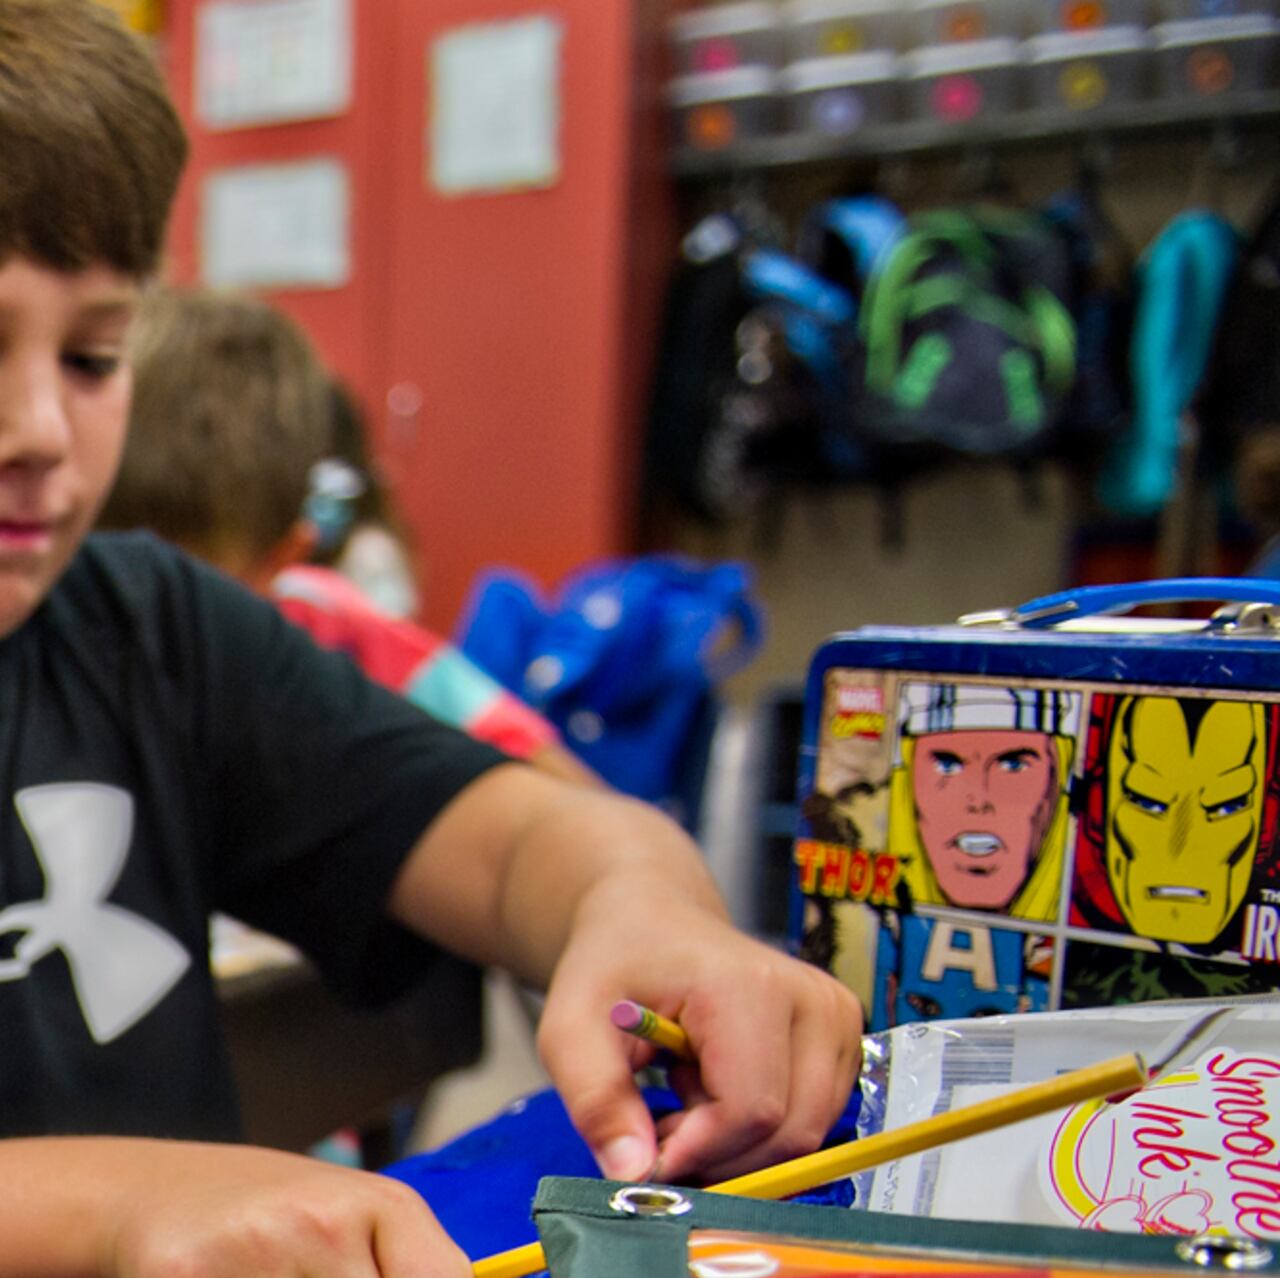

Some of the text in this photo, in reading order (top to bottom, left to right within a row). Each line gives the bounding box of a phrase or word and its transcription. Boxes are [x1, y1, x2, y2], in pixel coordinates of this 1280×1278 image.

[794, 840, 898, 906] THOR
[1243, 902, 1280, 962] IR
[1130, 1102, 1222, 1179] Ink
